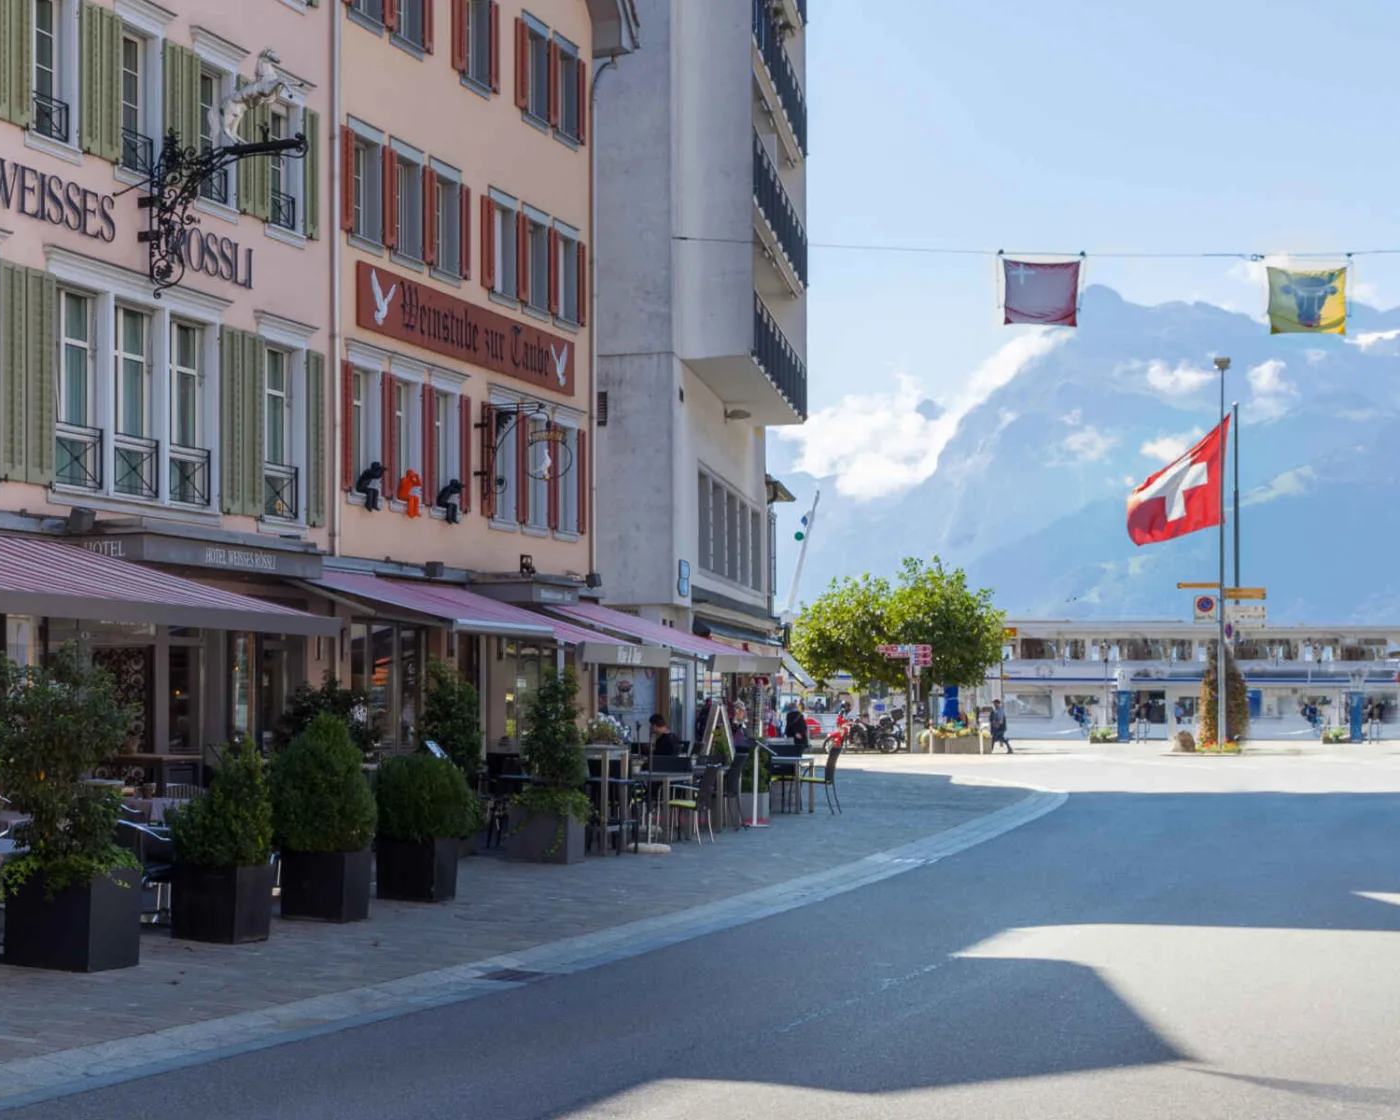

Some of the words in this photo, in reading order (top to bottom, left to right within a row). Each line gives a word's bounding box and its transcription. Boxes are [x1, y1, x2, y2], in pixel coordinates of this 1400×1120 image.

[400, 280, 479, 353] Weinstube
[484, 328, 505, 362] zur
[509, 325, 550, 377] Taube
[205, 547, 227, 564] HOTEL
